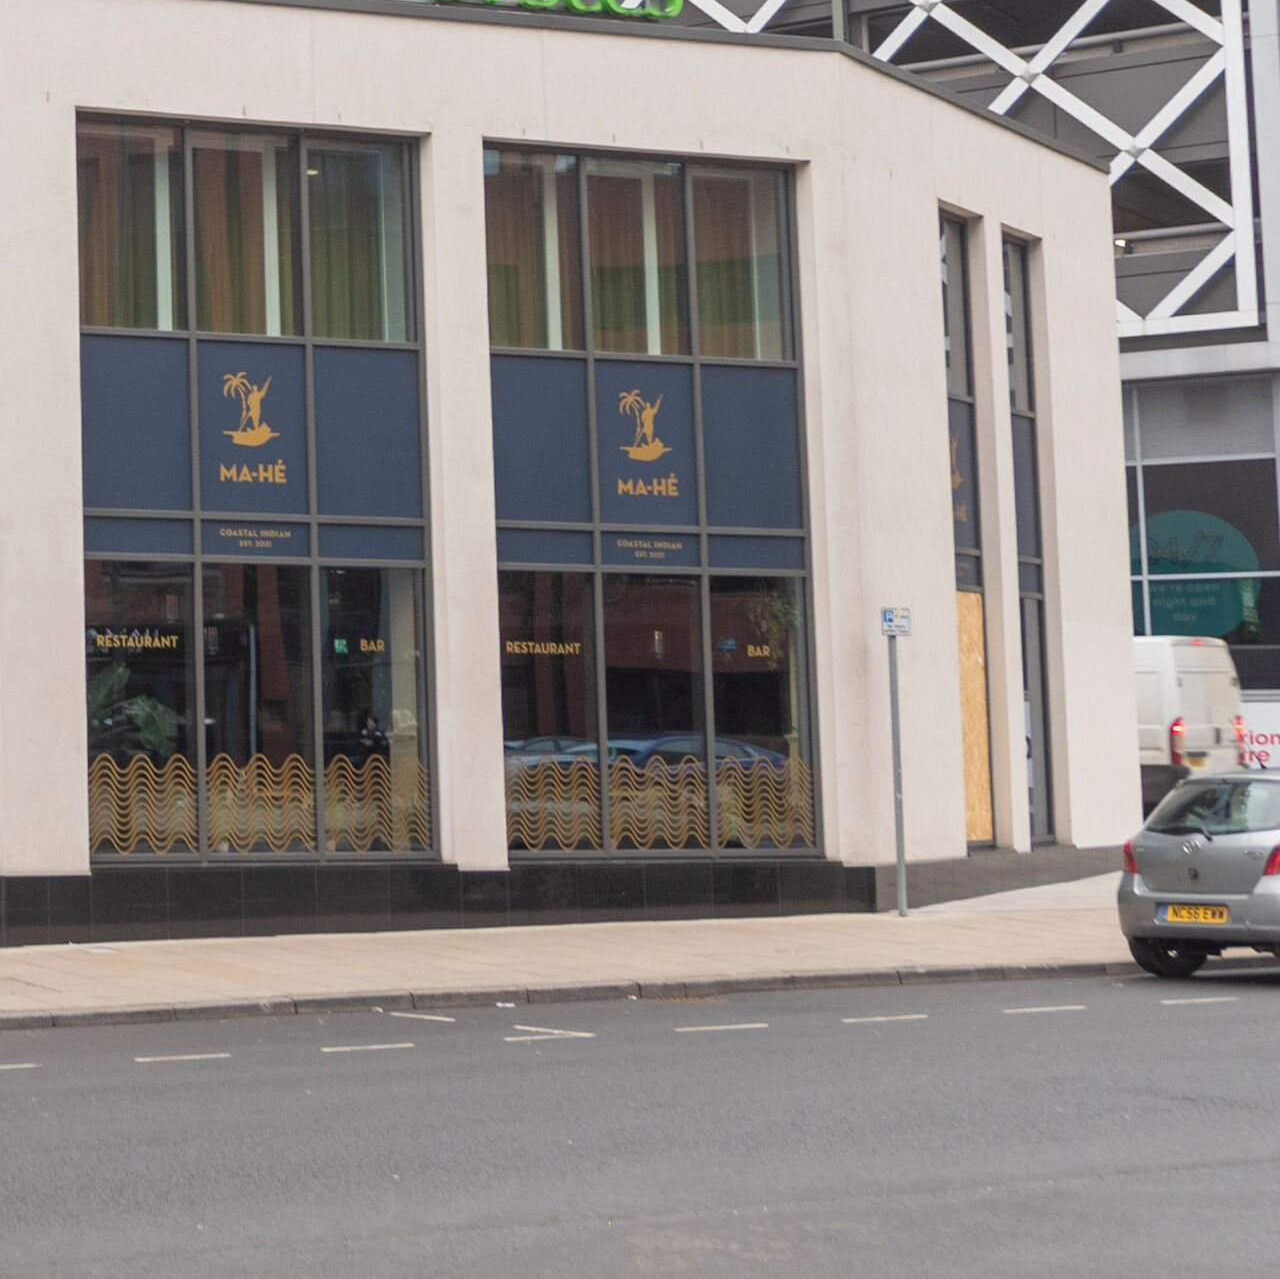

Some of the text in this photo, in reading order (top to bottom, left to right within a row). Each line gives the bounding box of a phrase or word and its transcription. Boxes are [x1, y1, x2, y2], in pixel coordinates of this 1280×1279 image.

[219, 458, 288, 485] MA-HÉ
[617, 472, 680, 497] MA-HÉ
[219, 527, 292, 539] COASTAL INDIAN
[616, 538, 683, 551] COASTAL INDIAN
[96, 633, 179, 649] RESTAURANT
[359, 638, 386, 652] BAR
[505, 640, 582, 655] RESTAURANT
[746, 644, 771, 658] BAR
